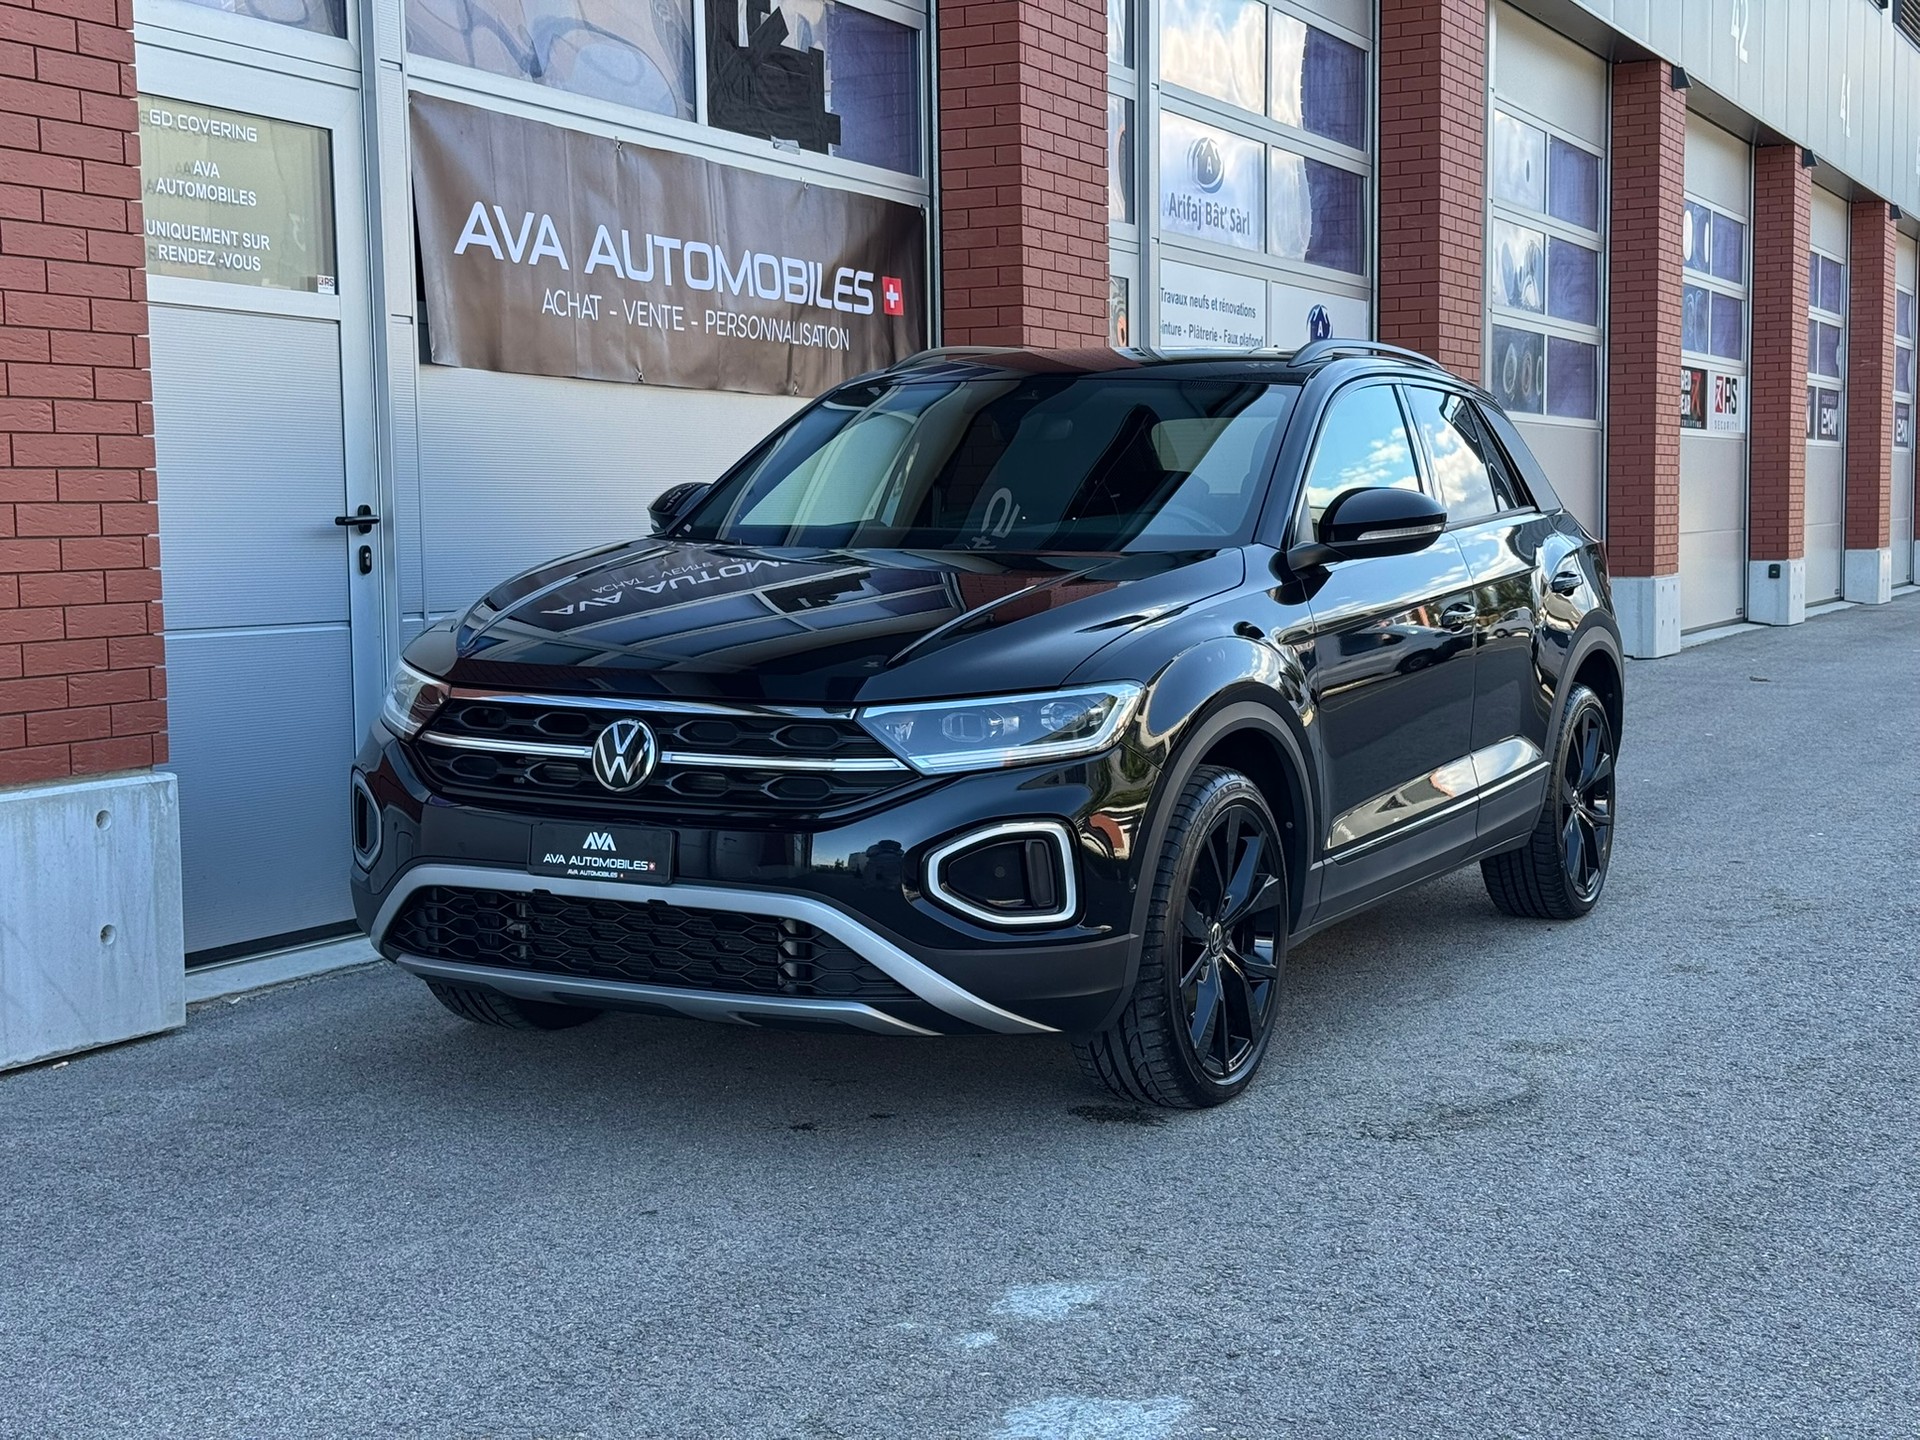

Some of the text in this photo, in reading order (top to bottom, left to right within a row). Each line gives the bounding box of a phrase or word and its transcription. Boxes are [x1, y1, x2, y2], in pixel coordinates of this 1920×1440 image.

[1731, 0, 1748, 63] 42
[150, 109, 257, 142] GD COVERING
[193, 160, 220, 179] AVA
[156, 177, 257, 207] AUTOMOBILES
[1168, 192, 1201, 230] Arifaj
[146, 219, 270, 251] UNIQUEMENT SUR
[158, 244, 216, 267] RENDEZ
[454, 201, 874, 315] AVA AUTOMOBILES
[1160, 287, 1256, 319] Travaux neufs et rénovations
[541, 288, 602, 321] ACHAT
[622, 298, 685, 332] VENTE
[705, 309, 850, 351] PERSONNALISATION
[1188, 323, 1218, 342] Plâtrerie
[1223, 329, 1239, 345] Faux
[1724, 376, 1738, 415] RS
[1714, 419, 1738, 431] SECURITY
[582, 831, 617, 851] AVA
[543, 853, 648, 871] AVA AUTOMOBILES
[580, 870, 618, 878] AUTOMOBILES
